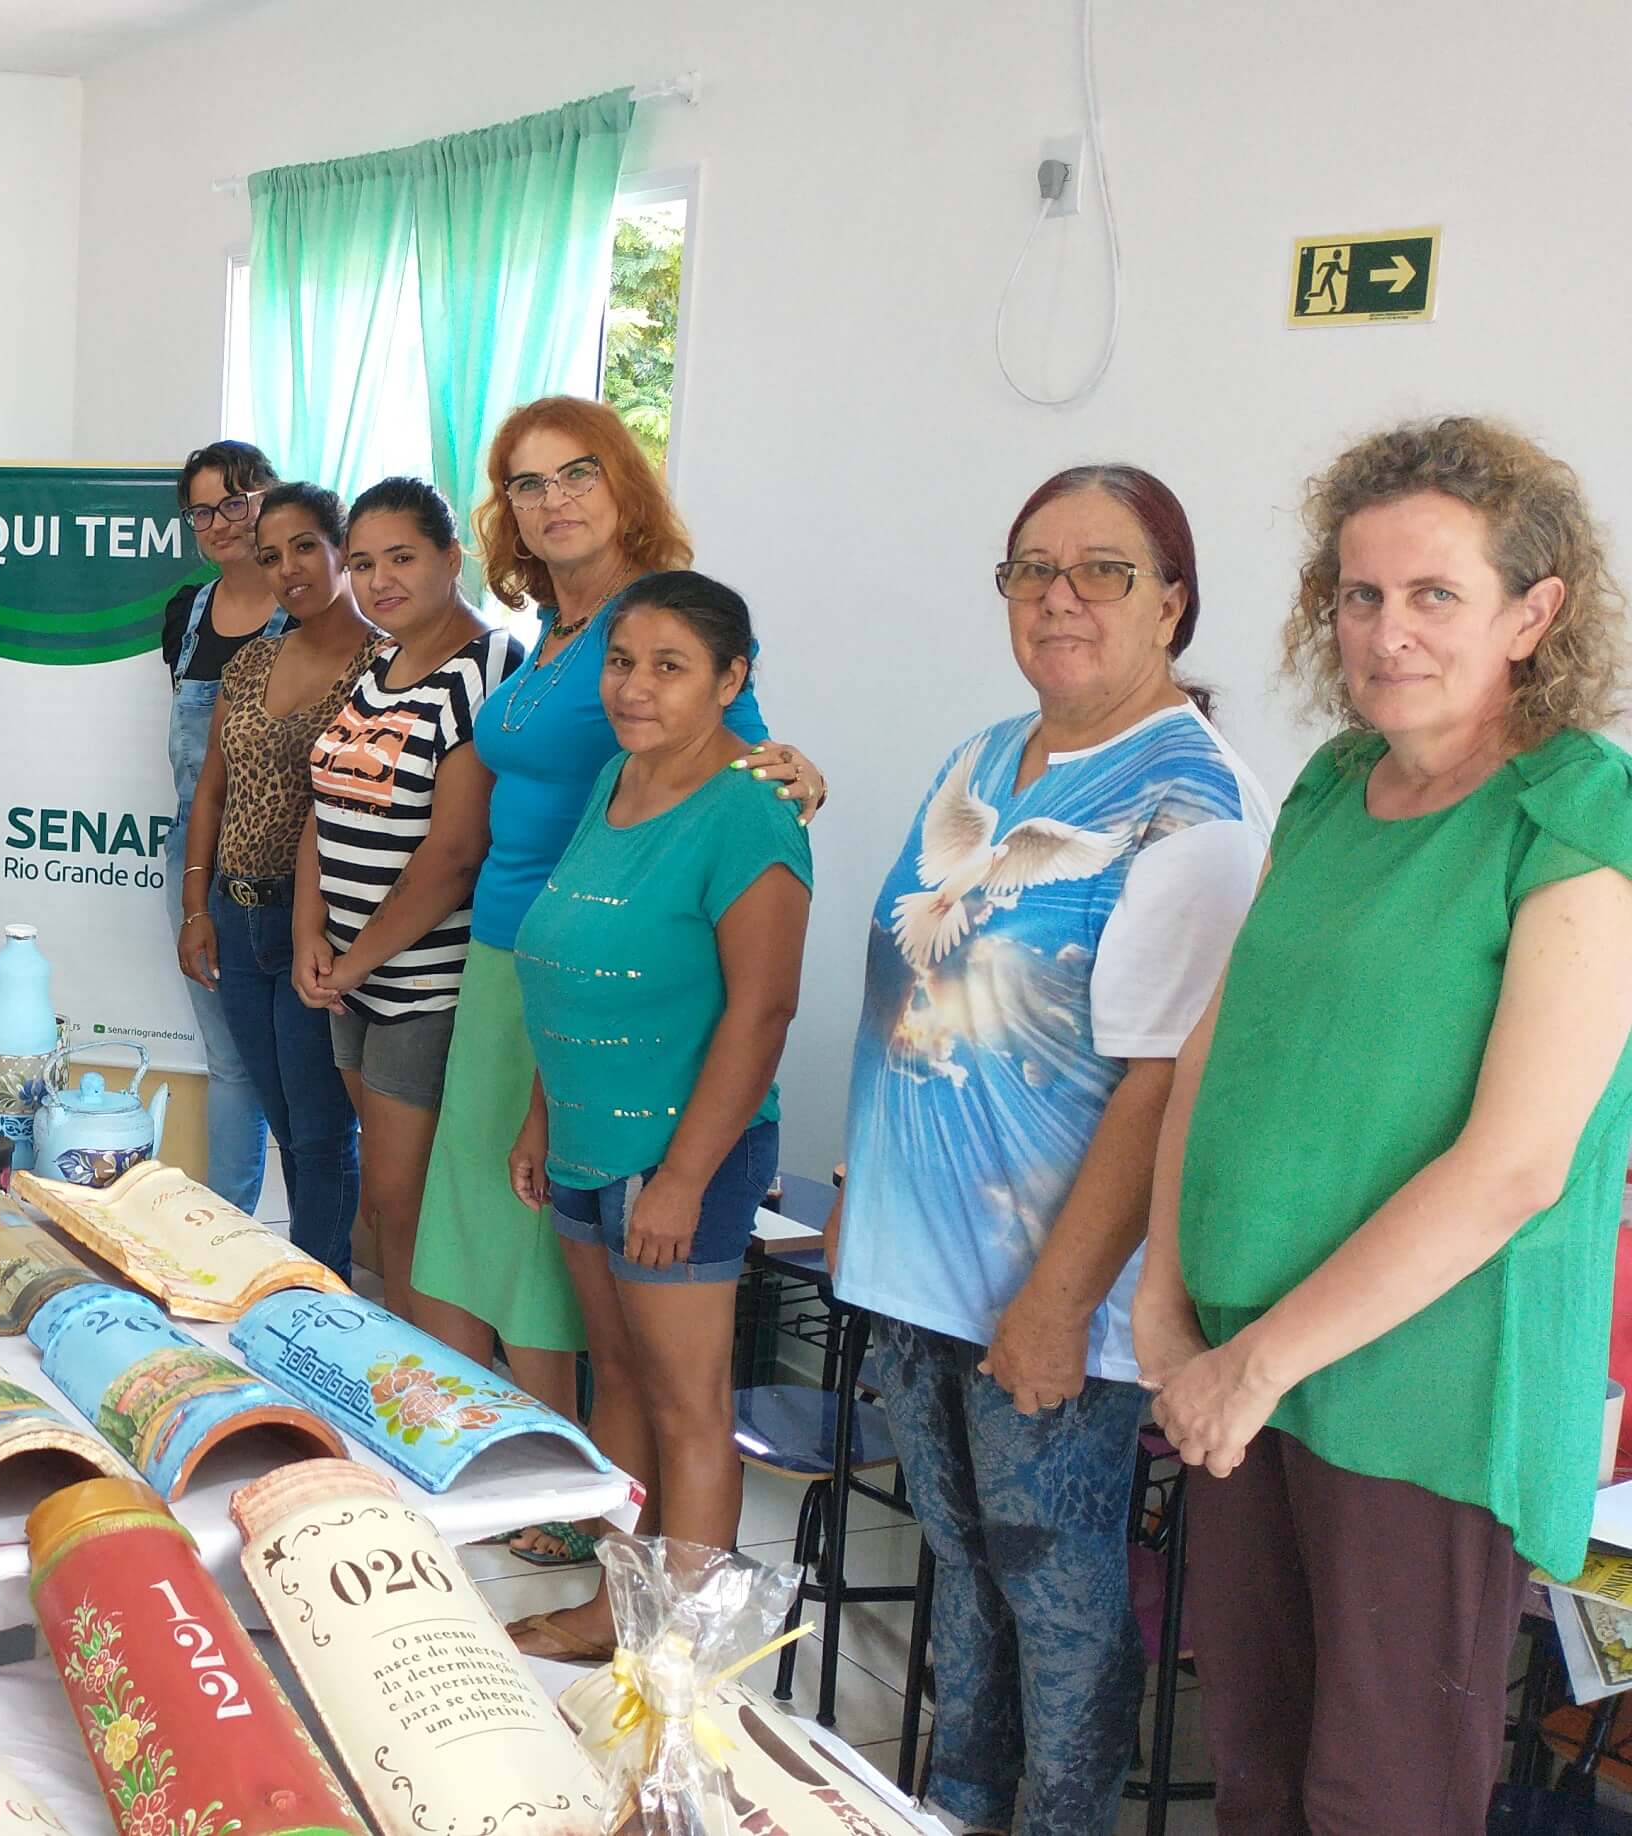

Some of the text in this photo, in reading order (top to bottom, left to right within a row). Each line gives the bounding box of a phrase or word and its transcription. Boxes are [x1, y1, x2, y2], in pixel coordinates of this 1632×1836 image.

[75, 516, 182, 558] TEM
[4, 857, 164, 889] Rio Grande do
[108, 1026, 195, 1041] senarriograndedosul
[330, 1548, 453, 1606] 026
[149, 1579, 253, 1719] 122
[392, 1630, 477, 1650] O sucesso
[373, 1652, 421, 1680] nasce
[427, 1645, 449, 1658] do
[381, 1658, 519, 1695] da determinação
[388, 1701, 399, 1712] e
[404, 1689, 425, 1704] da
[400, 1703, 440, 1730] para
[446, 1695, 464, 1707] se
[470, 1688, 525, 1705] chegar
[425, 1704, 536, 1734] um objetivo.
